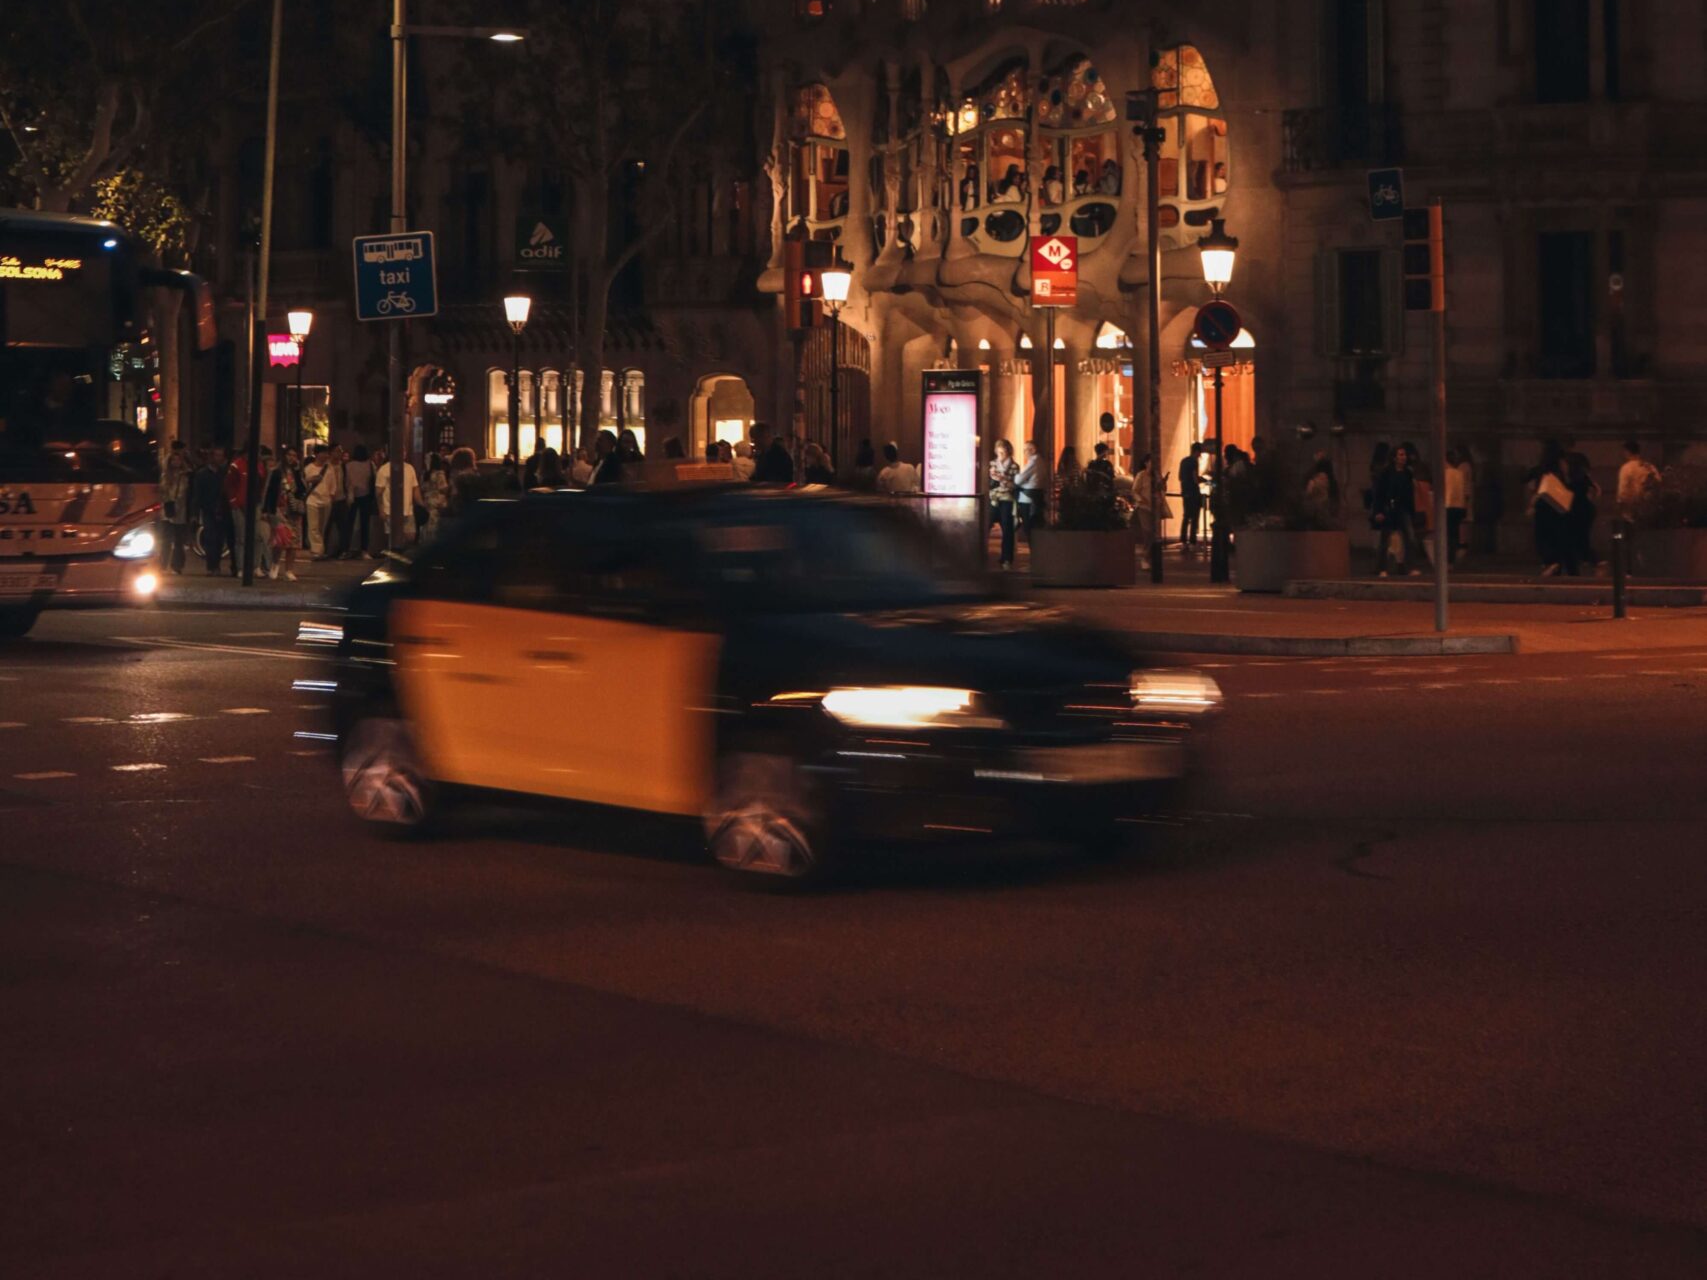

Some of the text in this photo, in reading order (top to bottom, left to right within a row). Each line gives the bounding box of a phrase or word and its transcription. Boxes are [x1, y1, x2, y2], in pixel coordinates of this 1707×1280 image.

[520, 245, 563, 259] adif
[1048, 245, 1062, 257] M
[379, 267, 411, 286] taxi
